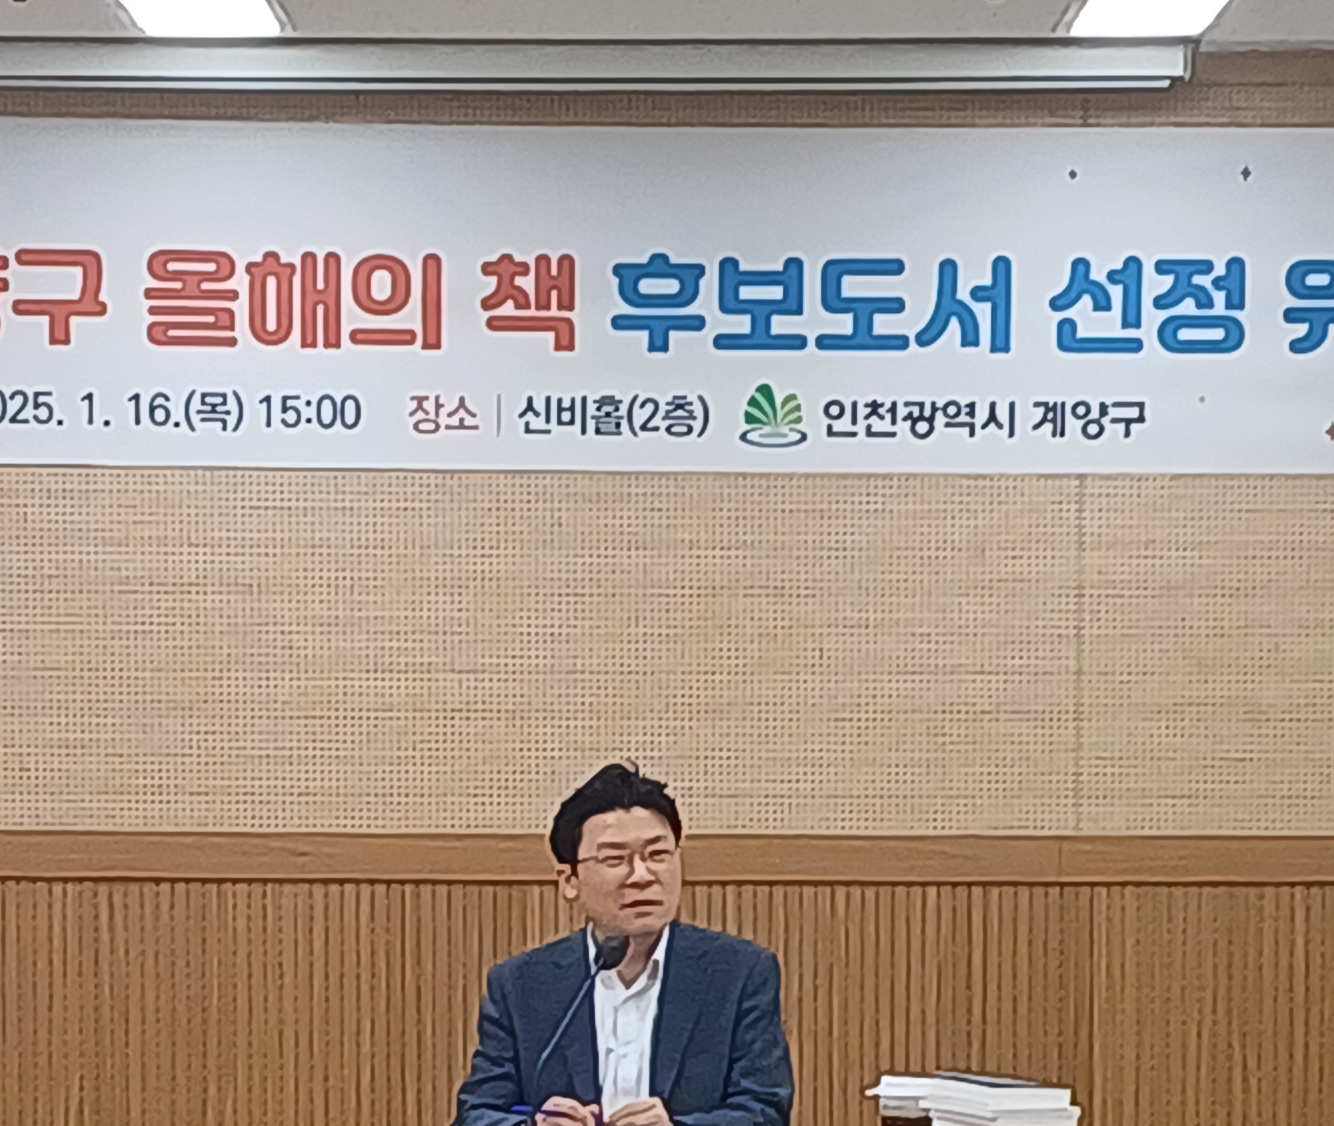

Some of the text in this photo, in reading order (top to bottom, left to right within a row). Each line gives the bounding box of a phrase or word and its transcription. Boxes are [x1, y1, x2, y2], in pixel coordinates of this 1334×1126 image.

[143, 249, 442, 350] 올해의
[480, 253, 577, 352] 책
[610, 252, 1012, 354] 후보도서
[1048, 255, 1247, 354] 선정
[80, 392, 112, 427] 1.
[126, 389, 245, 433] 16.(목)
[258, 394, 363, 431] 15:00
[408, 395, 481, 437] 장소
[518, 393, 711, 438] 신비홀(2층)
[822, 398, 1148, 440] 인천광역시 계양구
